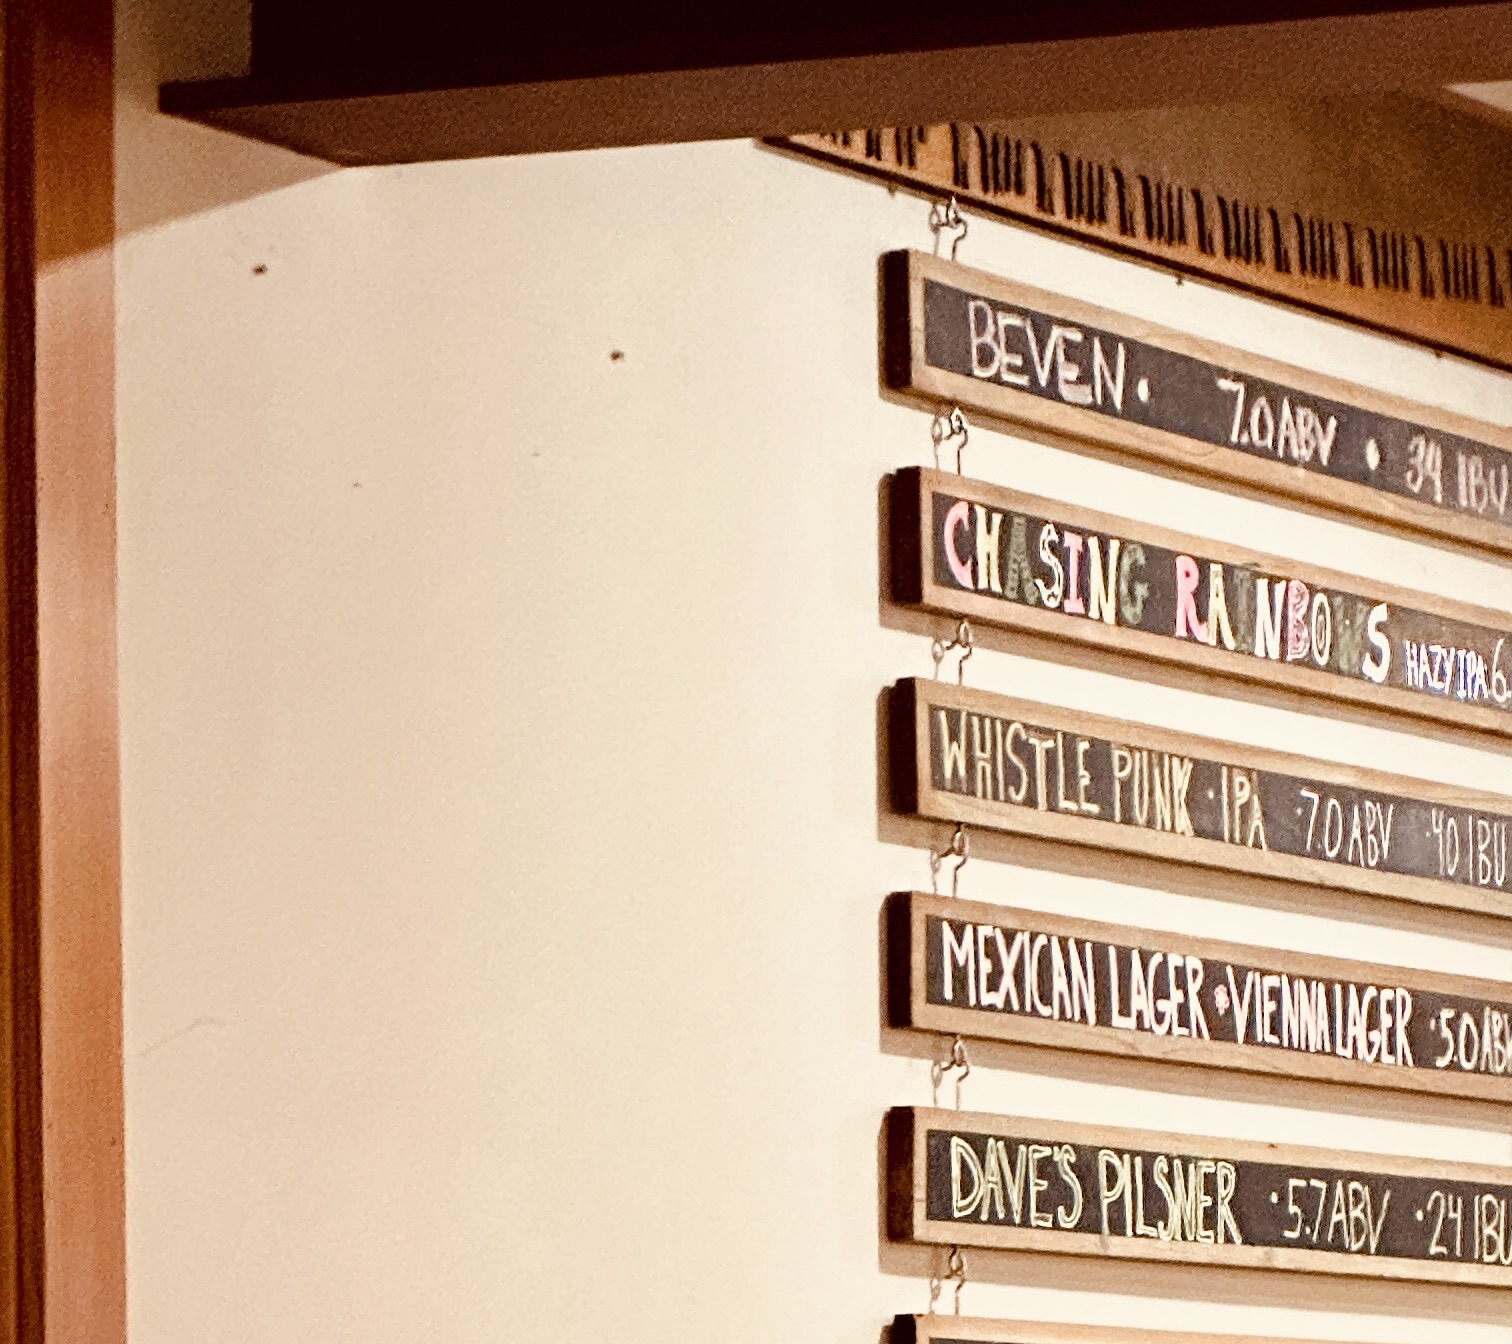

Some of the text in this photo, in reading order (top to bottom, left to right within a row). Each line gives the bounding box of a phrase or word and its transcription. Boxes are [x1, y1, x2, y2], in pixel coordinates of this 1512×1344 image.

[967, 300, 1125, 411] BEVEN
[944, 501, 1149, 625] CHASING
[1405, 640, 1455, 694] HAZY
[937, 710, 1100, 812] WHISTLE
[1111, 750, 1193, 837] PUNK
[1221, 766, 1267, 851] IPA
[1469, 815, 1507, 886] IBU
[942, 921, 1096, 1026] MEXICAN
[1109, 945, 1210, 1040] LAGER
[1226, 965, 1332, 1054] VIENNA
[1334, 983, 1415, 1067] LAGER
[950, 1135, 1083, 1229] DAVE'S
[1098, 1149, 1242, 1245] PILSNER
